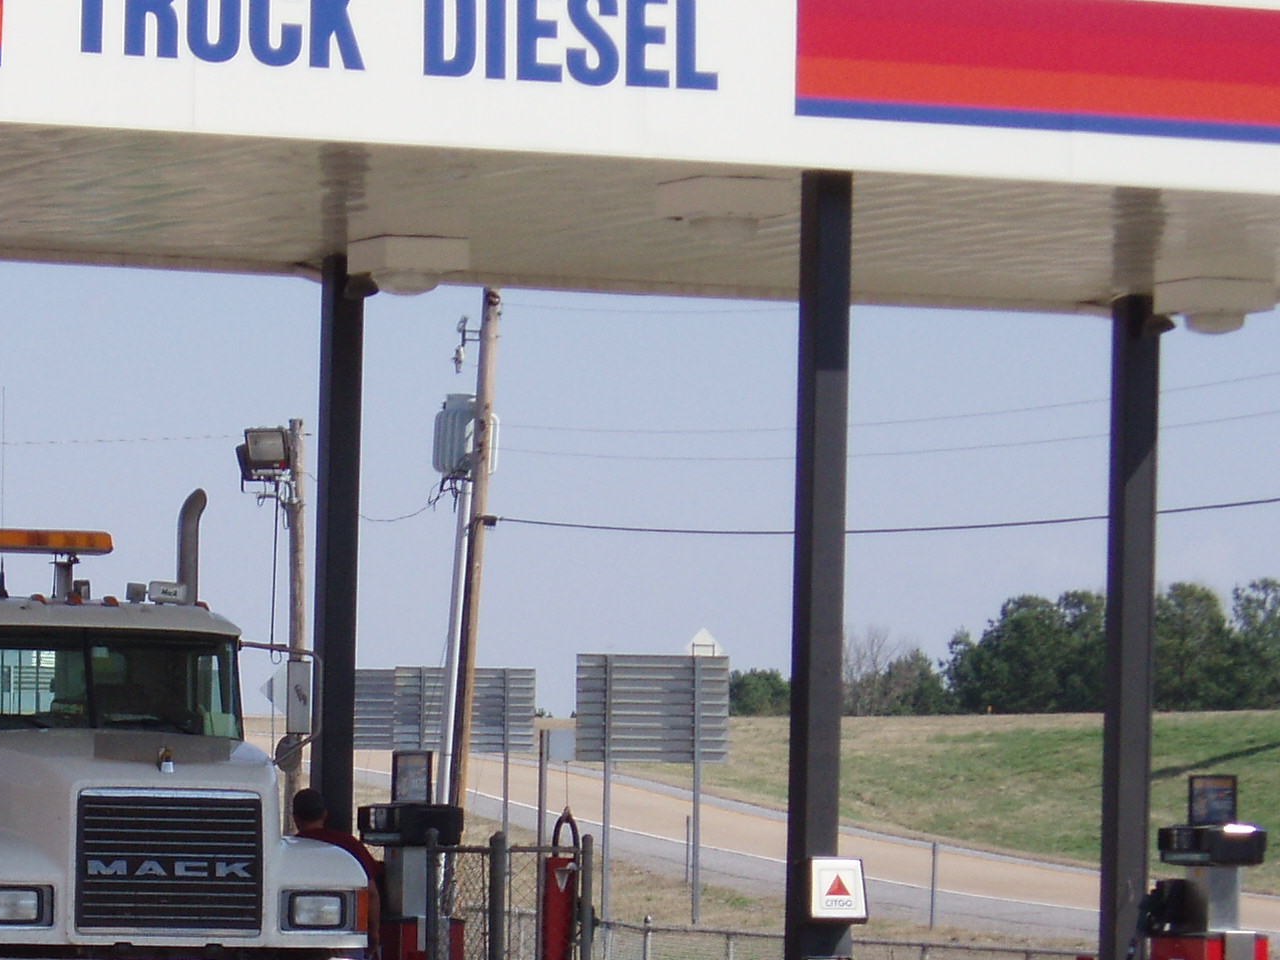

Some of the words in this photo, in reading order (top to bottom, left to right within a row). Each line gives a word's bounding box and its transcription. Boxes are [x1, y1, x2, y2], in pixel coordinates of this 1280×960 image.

[423, 0, 718, 90] DIESEL
[87, 859, 252, 878] MACK
[825, 898, 852, 907] CITGO
